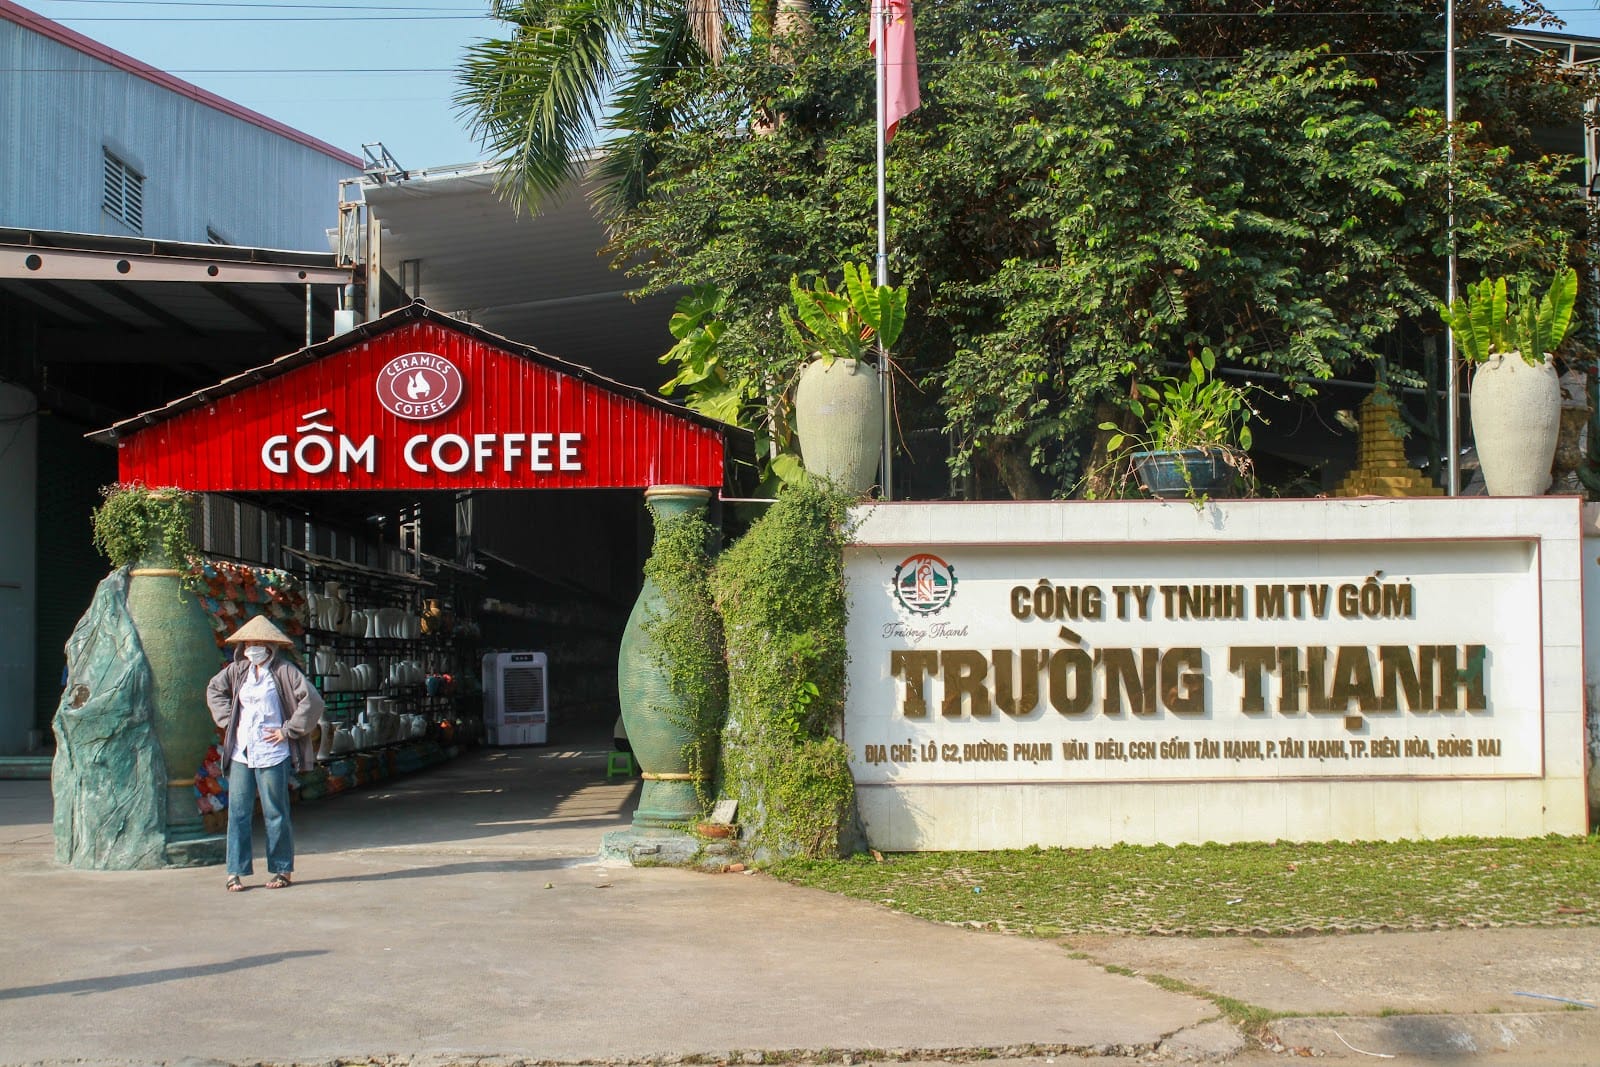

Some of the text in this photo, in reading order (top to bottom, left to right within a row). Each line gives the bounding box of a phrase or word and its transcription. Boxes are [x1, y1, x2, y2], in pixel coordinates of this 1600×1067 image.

[386, 356, 452, 377] CERAMICS
[395, 399, 447, 416] COFFEE
[261, 408, 582, 474] GỐM COFFEE
[1010, 570, 1412, 619] CÔNG TY TNHH MTV GỐM
[928, 621, 969, 640] Thạnh
[890, 625, 1487, 730] TRƯỜNG THẠNH
[865, 743, 888, 766] ĐỊA
[920, 740, 938, 763] LÔ
[1013, 743, 1052, 765] PHẠM
[1062, 739, 1089, 760] VĂN
[1159, 736, 1190, 760] GỐM
[1194, 738, 1220, 759] TÂN
[1477, 738, 1502, 757] NAI
